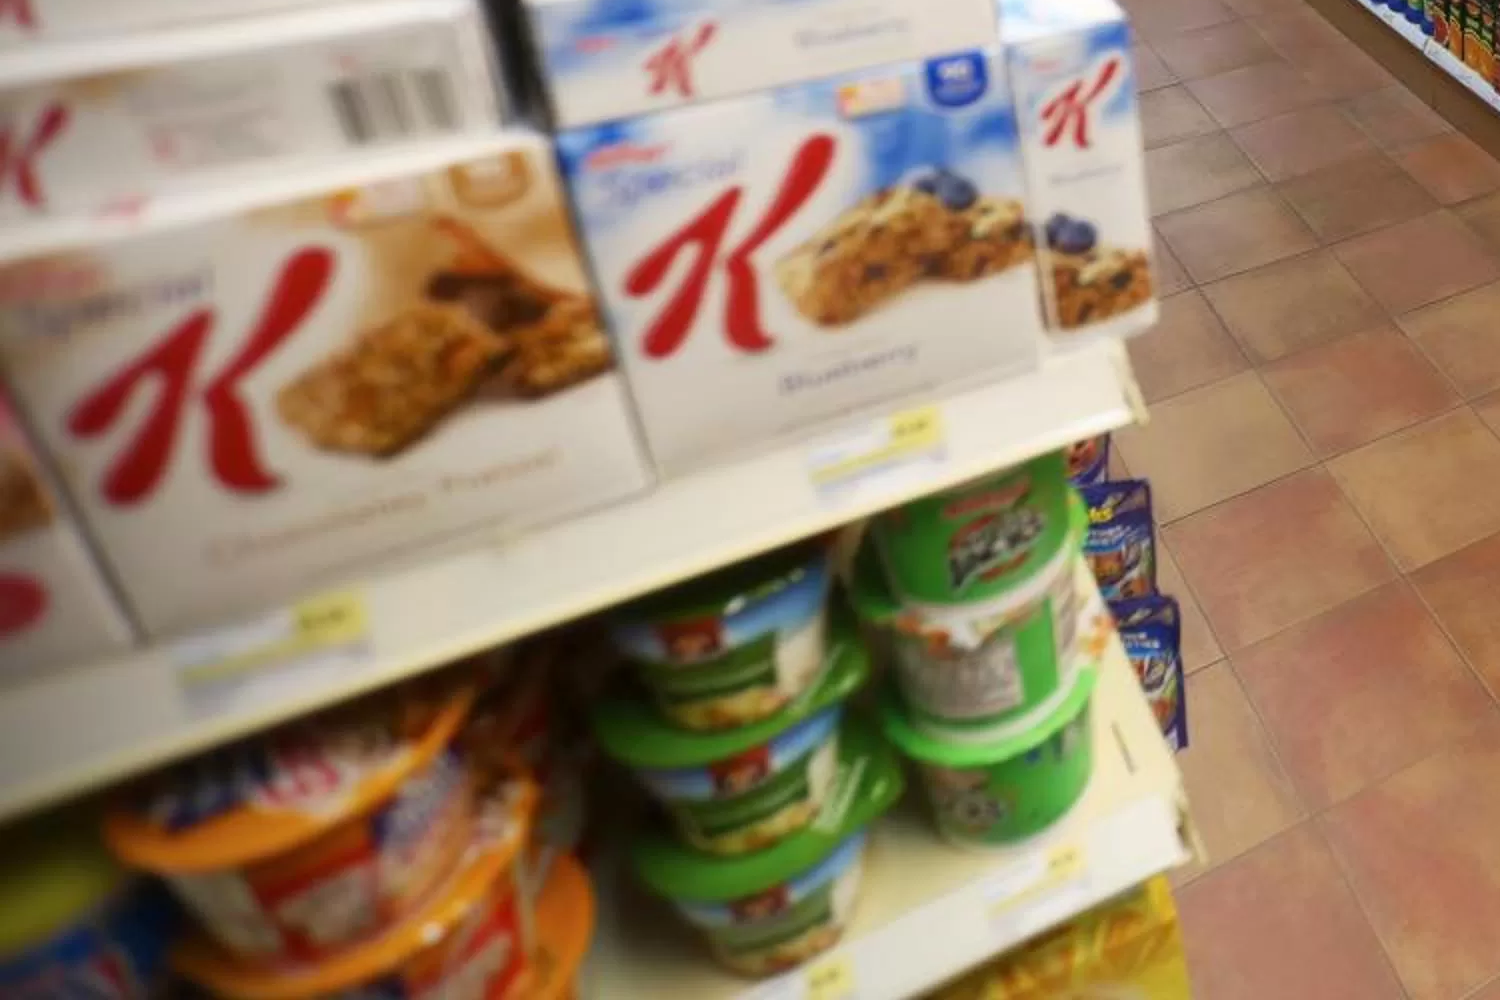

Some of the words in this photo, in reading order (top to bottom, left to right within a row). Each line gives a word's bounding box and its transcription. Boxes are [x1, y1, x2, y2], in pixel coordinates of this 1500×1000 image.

[645, 23, 719, 97] K
[1041, 57, 1121, 150] K
[622, 133, 837, 359] K
[66, 247, 338, 506] K
[779, 344, 920, 396] Blueberry
